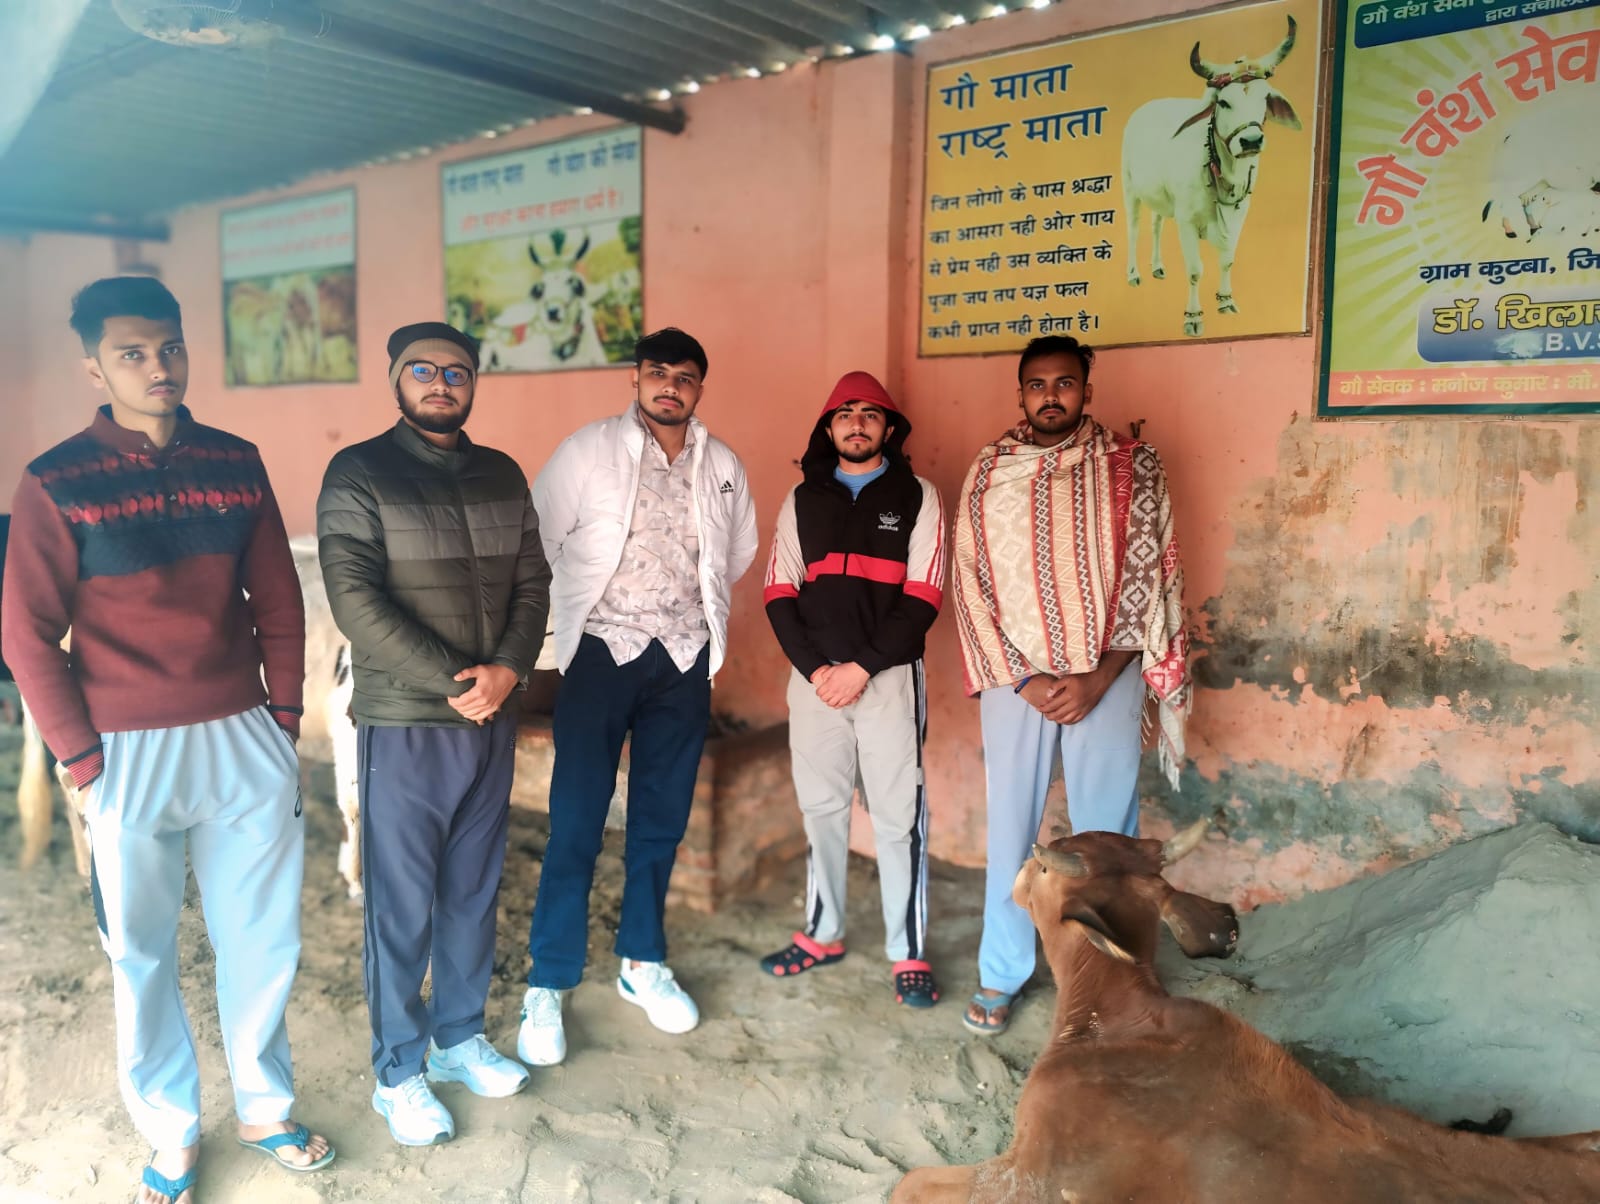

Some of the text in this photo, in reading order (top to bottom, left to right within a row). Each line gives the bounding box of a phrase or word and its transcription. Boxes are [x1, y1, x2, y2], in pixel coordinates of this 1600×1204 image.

[1393, 1, 1428, 19] वंश
[1433, 0, 1474, 13] सवा
[1485, 5, 1518, 22] द्वारा
[939, 63, 1073, 111] गौ माता
[938, 106, 1109, 159] राष्ट्र माता
[1357, 25, 1600, 226] गौ वंश सेव
[931, 194, 960, 213] जिन
[1010, 182, 1027, 202] के
[1032, 181, 1066, 199] पास
[1071, 175, 1113, 195] श्रद्धा
[929, 230, 951, 245] का
[956, 223, 1004, 242] आसरा
[1010, 214, 1036, 236] नही
[1080, 209, 1116, 227] गाय
[946, 256, 970, 275] प्रेम
[975, 252, 1001, 272] नही
[1006, 253, 1031, 270] उस
[1036, 243, 1088, 265] व्यक्ति
[1092, 239, 1112, 261] के
[1420, 262, 1472, 284] ग्राम
[1567, 247, 1600, 271] जि
[962, 290, 988, 306] जप
[994, 287, 1017, 302] तप
[1021, 285, 1050, 302] यज्ञ
[1054, 281, 1090, 298] फल
[928, 320, 961, 339] कभी
[967, 321, 1001, 338] प्राप्त
[1005, 314, 1034, 335] नही
[1038, 312, 1074, 335] होता
[1433, 293, 1600, 334] डॉ. खिला
[1367, 374, 1415, 396] सेवक
[1432, 372, 1488, 393] मनोज
[1493, 374, 1549, 400] कुमार
